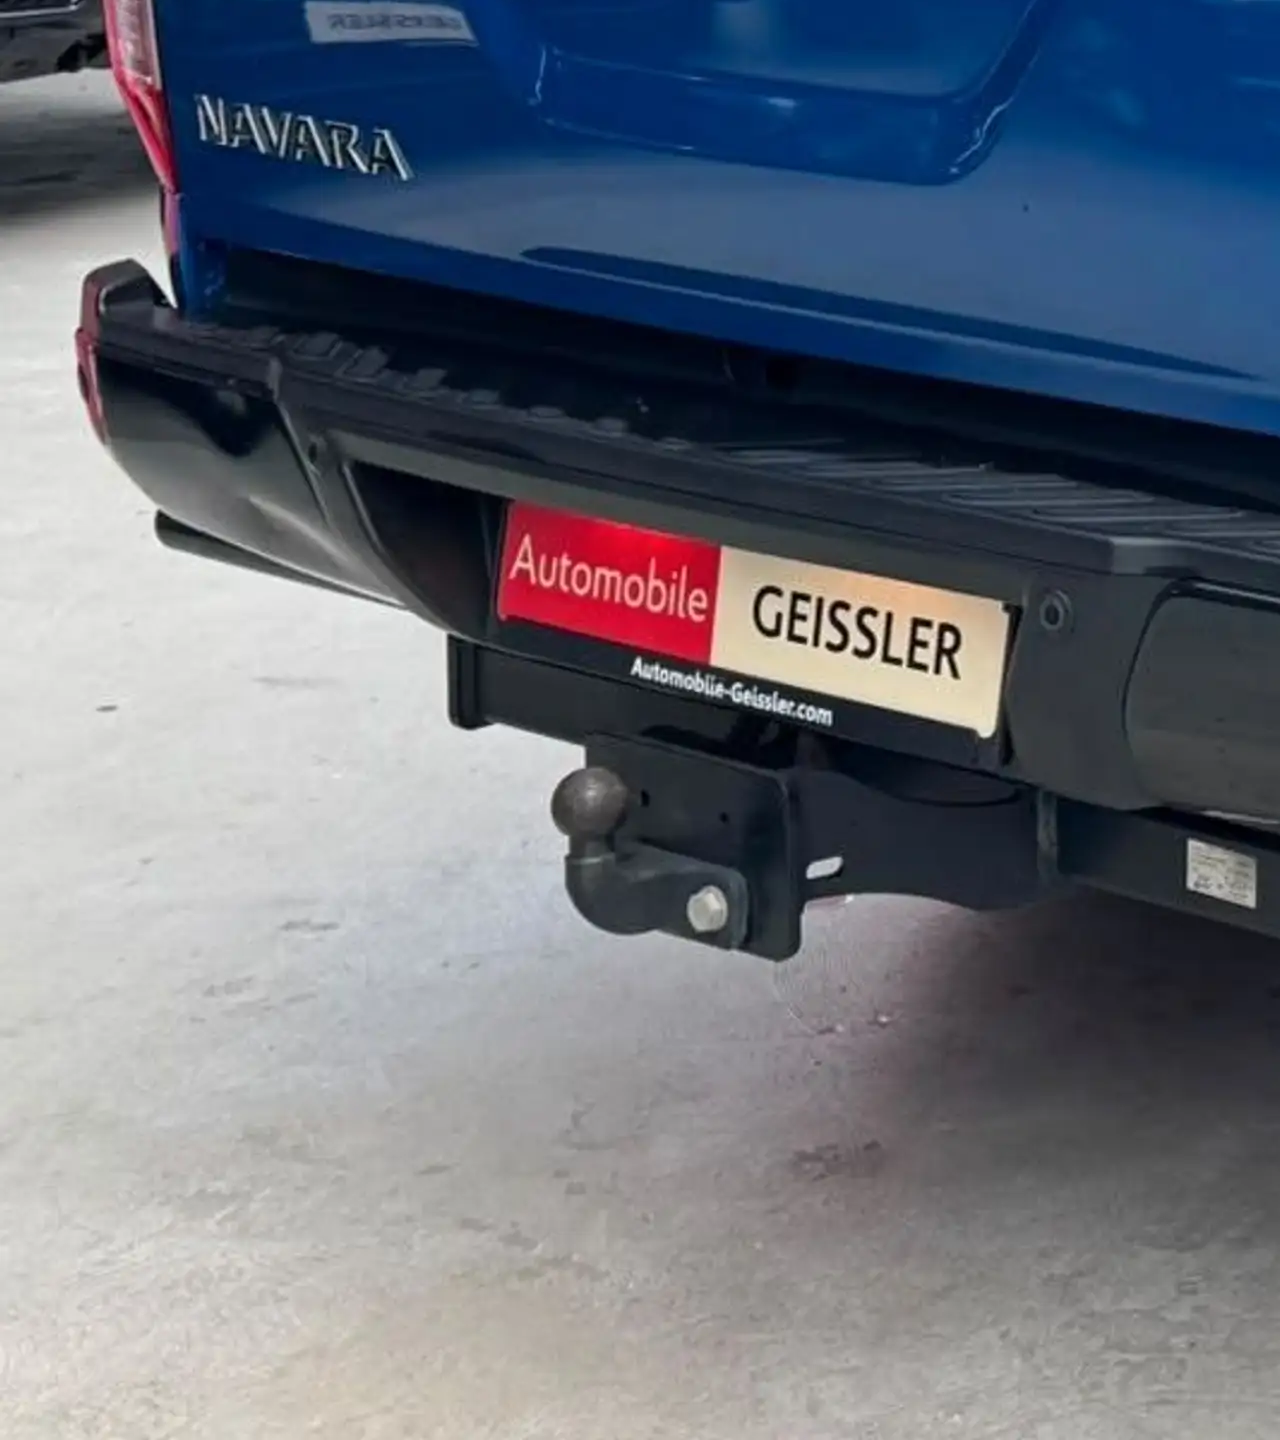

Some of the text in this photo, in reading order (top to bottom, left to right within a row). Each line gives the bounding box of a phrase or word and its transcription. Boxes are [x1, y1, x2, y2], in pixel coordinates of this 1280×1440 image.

[194, 93, 412, 181] NAVARA
[509, 533, 961, 680] Automobile GEISSLER
